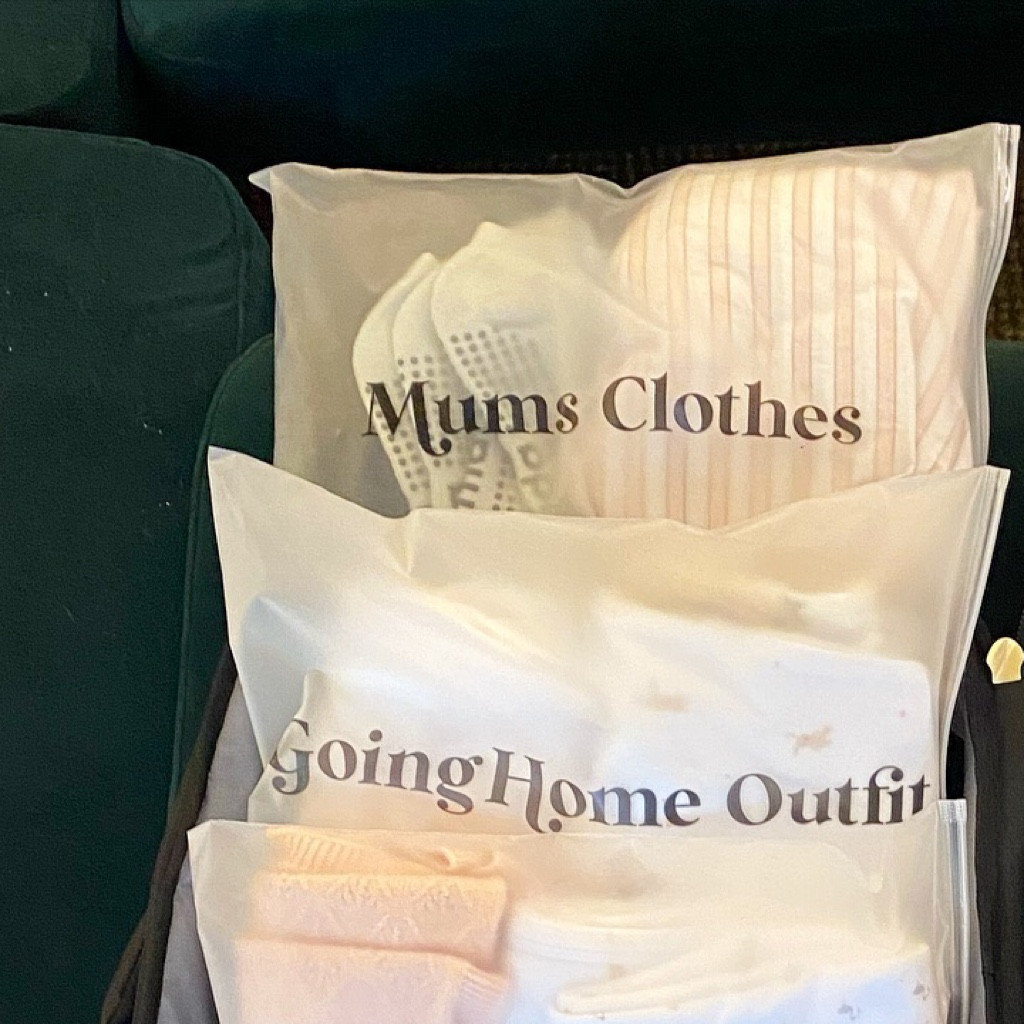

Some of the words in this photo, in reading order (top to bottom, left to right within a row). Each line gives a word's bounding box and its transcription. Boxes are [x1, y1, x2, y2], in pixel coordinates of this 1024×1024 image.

[361, 380, 579, 457] Mums
[602, 374, 863, 445] Clothes
[269, 719, 484, 817] Going
[484, 746, 701, 834] Home
[727, 764, 931, 826] Outfit
